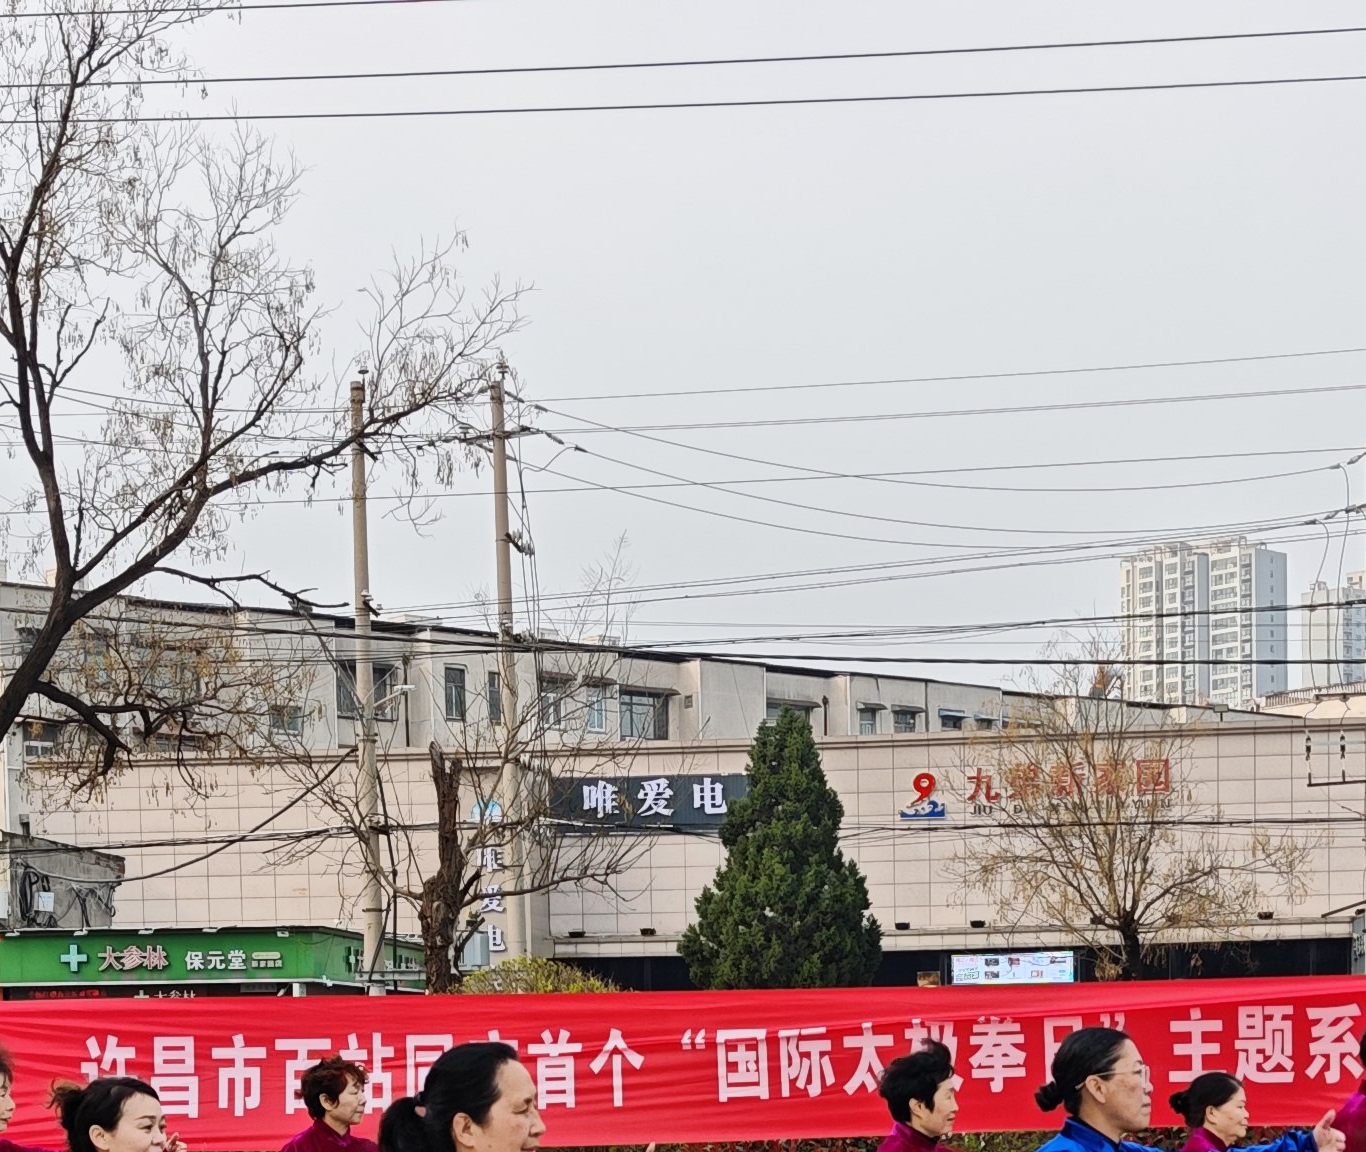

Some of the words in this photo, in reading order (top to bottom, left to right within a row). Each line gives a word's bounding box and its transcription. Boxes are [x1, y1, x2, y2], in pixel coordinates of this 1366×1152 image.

[582, 777, 728, 819] 唯爱电
[98, 945, 169, 971] 大参林
[185, 950, 247, 970] 保元堂
